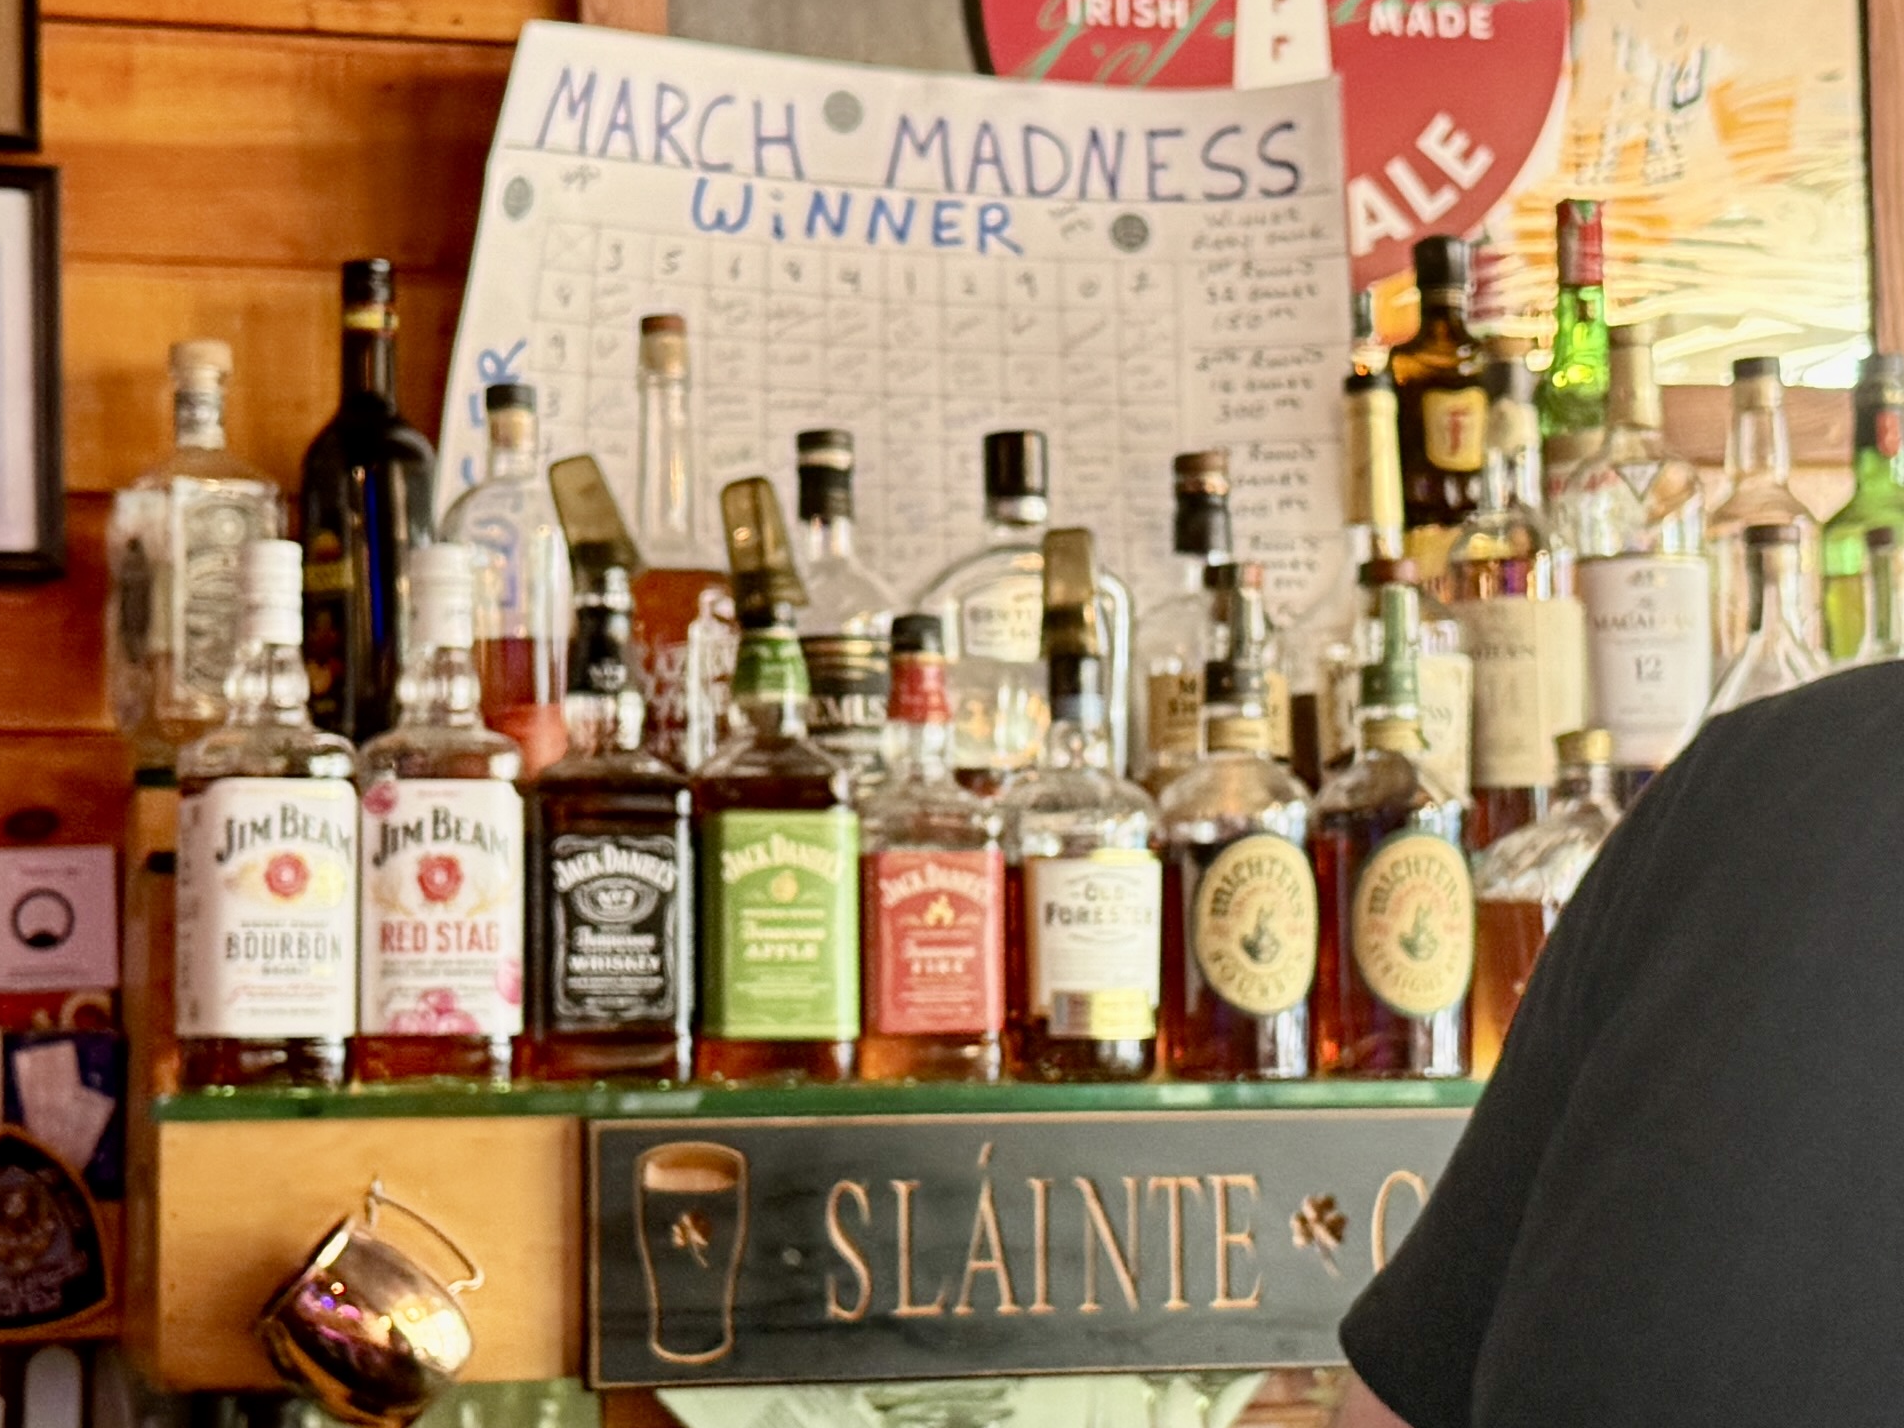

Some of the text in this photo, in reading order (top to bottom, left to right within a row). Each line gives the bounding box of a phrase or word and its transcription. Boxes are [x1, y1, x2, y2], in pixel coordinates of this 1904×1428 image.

[1369, 1, 1496, 40] MADE
[535, 65, 1304, 204] MARCH MADNESS
[1350, 112, 1496, 256] ALE
[216, 802, 355, 864] JIM BEAM
[373, 806, 511, 867] JIM BEAM
[553, 849, 602, 892] JACK
[722, 841, 769, 884] JACK
[1083, 882, 1124, 902] OLD
[225, 930, 344, 961] BOURBON
[379, 920, 499, 954] RED STAG
[744, 942, 820, 962] APPLE
[568, 952, 662, 973] WHISKEY
[823, 1141, 1264, 1322] SLÁINTE
